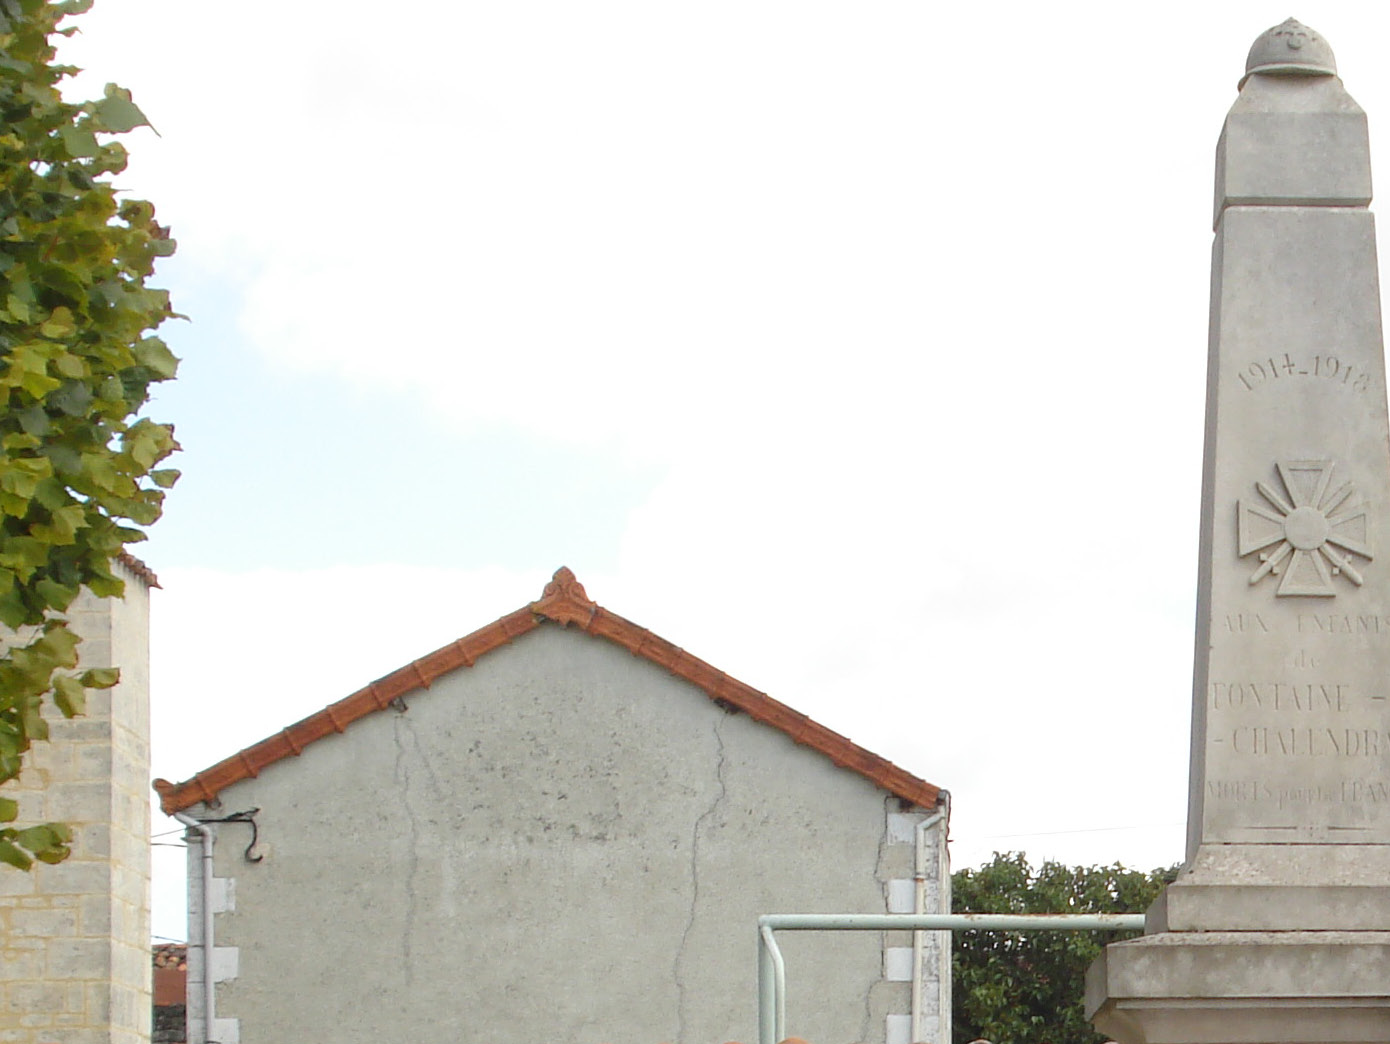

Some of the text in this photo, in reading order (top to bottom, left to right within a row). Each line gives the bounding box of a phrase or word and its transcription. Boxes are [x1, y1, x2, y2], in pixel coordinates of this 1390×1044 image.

[1224, 613, 1268, 633] AUX
[1294, 648, 1321, 669] de
[1212, 682, 1350, 712] FONTAINE
